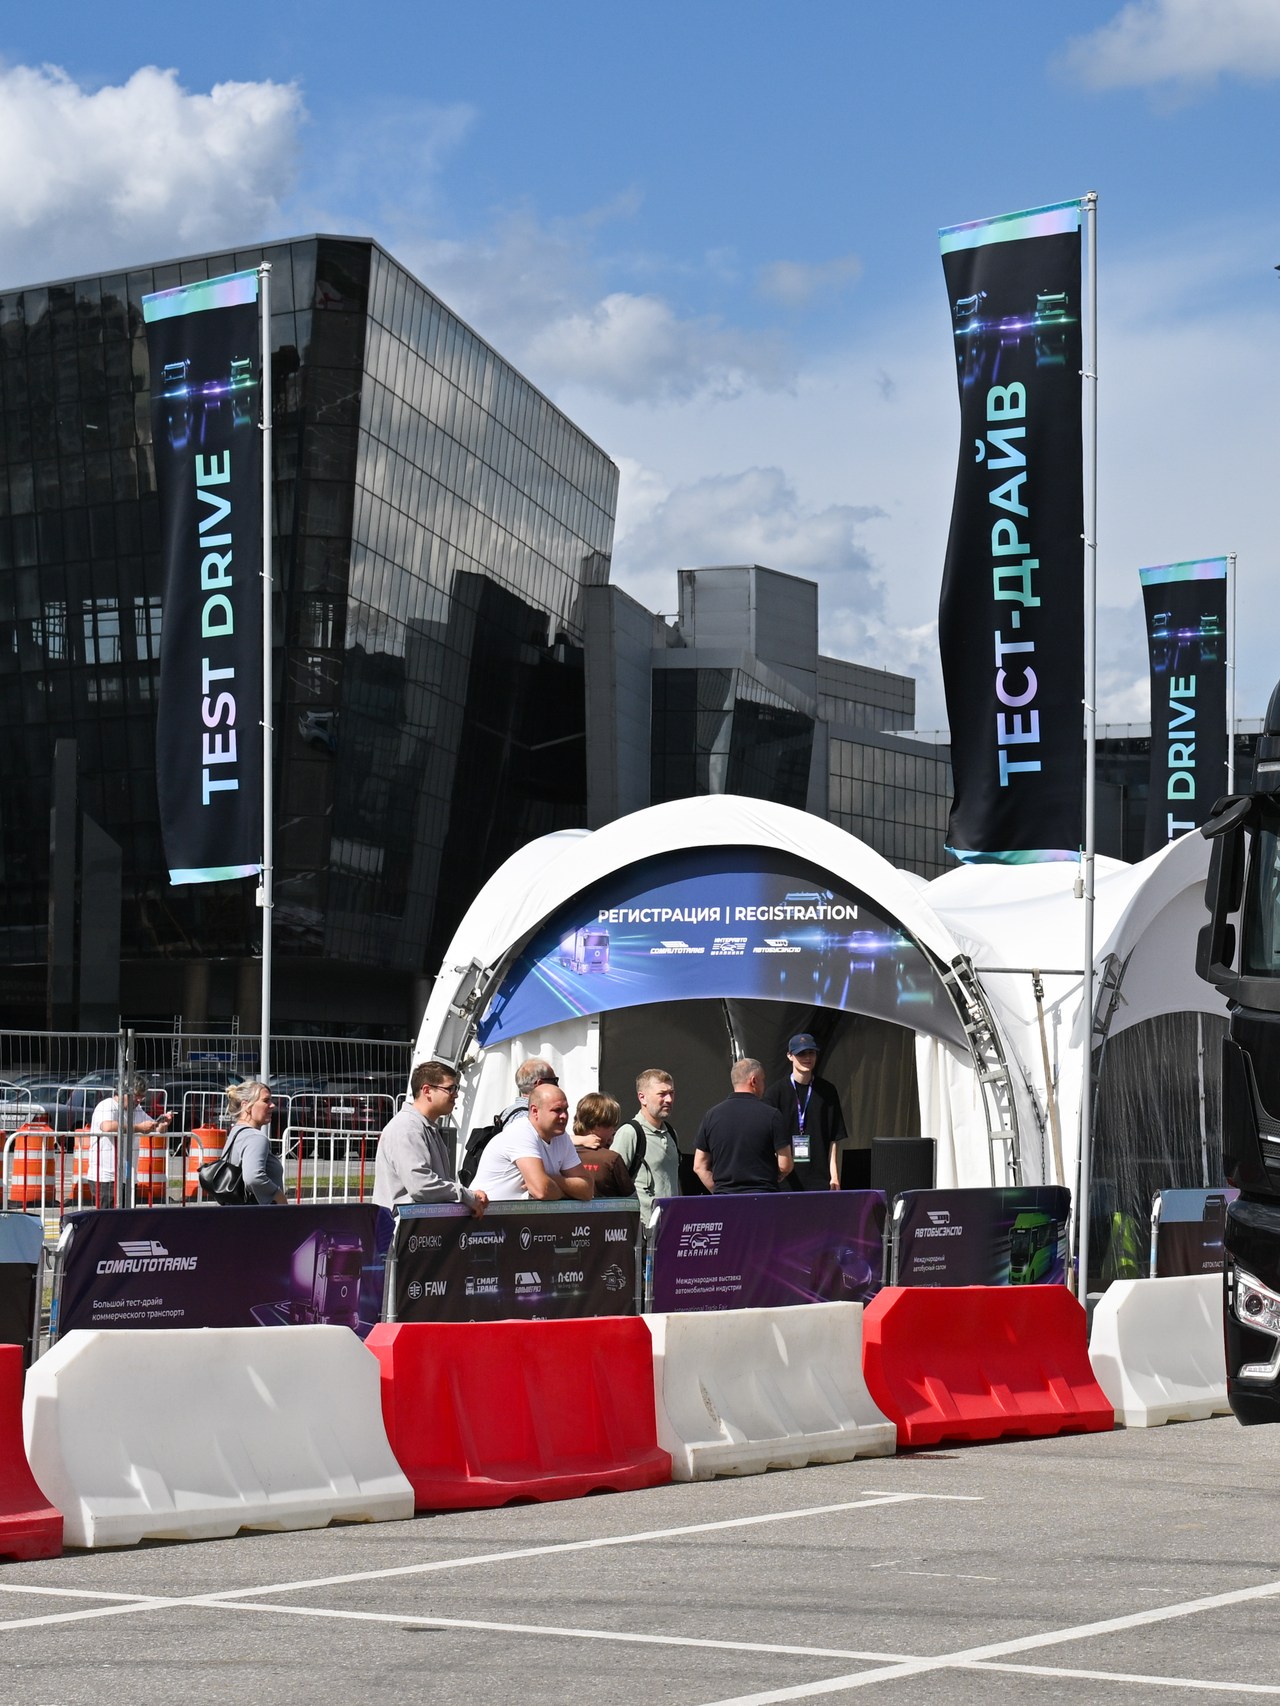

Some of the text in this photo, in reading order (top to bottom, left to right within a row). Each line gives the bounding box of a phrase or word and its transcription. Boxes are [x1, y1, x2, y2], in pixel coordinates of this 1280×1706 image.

[975, 381, 1042, 787] ТЕСТ-ДРАЙВ
[195, 450, 238, 805] TEST DRIVE
[1167, 675, 1196, 800] DRIVE
[598, 907, 721, 924] РЕГИСТРАЦИЯ
[735, 905, 858, 921] REGISTRATION
[571, 1226, 591, 1237] JAC
[682, 1222, 723, 1233] ИНТЕРАВТО
[914, 1226, 963, 1238] АВТОБУСЭКСПО
[468, 1235, 505, 1245] SHACMAN
[533, 1234, 557, 1242] FOTON
[604, 1228, 628, 1242] KAMAZ
[570, 1239, 591, 1247] MOTORS
[676, 1248, 719, 1257] МЕХАНИКА
[96, 1257, 198, 1275] COMAUTOTRANS
[476, 1277, 499, 1285] СМАРТ
[675, 1276, 718, 1285] Международная
[424, 1281, 447, 1297] FAW
[476, 1285, 499, 1293] ТРАНС
[675, 1284, 742, 1295] автомобильной индустрии
[93, 1297, 163, 1308] Большой тест-драйв
[92, 1309, 185, 1321] коммерческого транспорта
